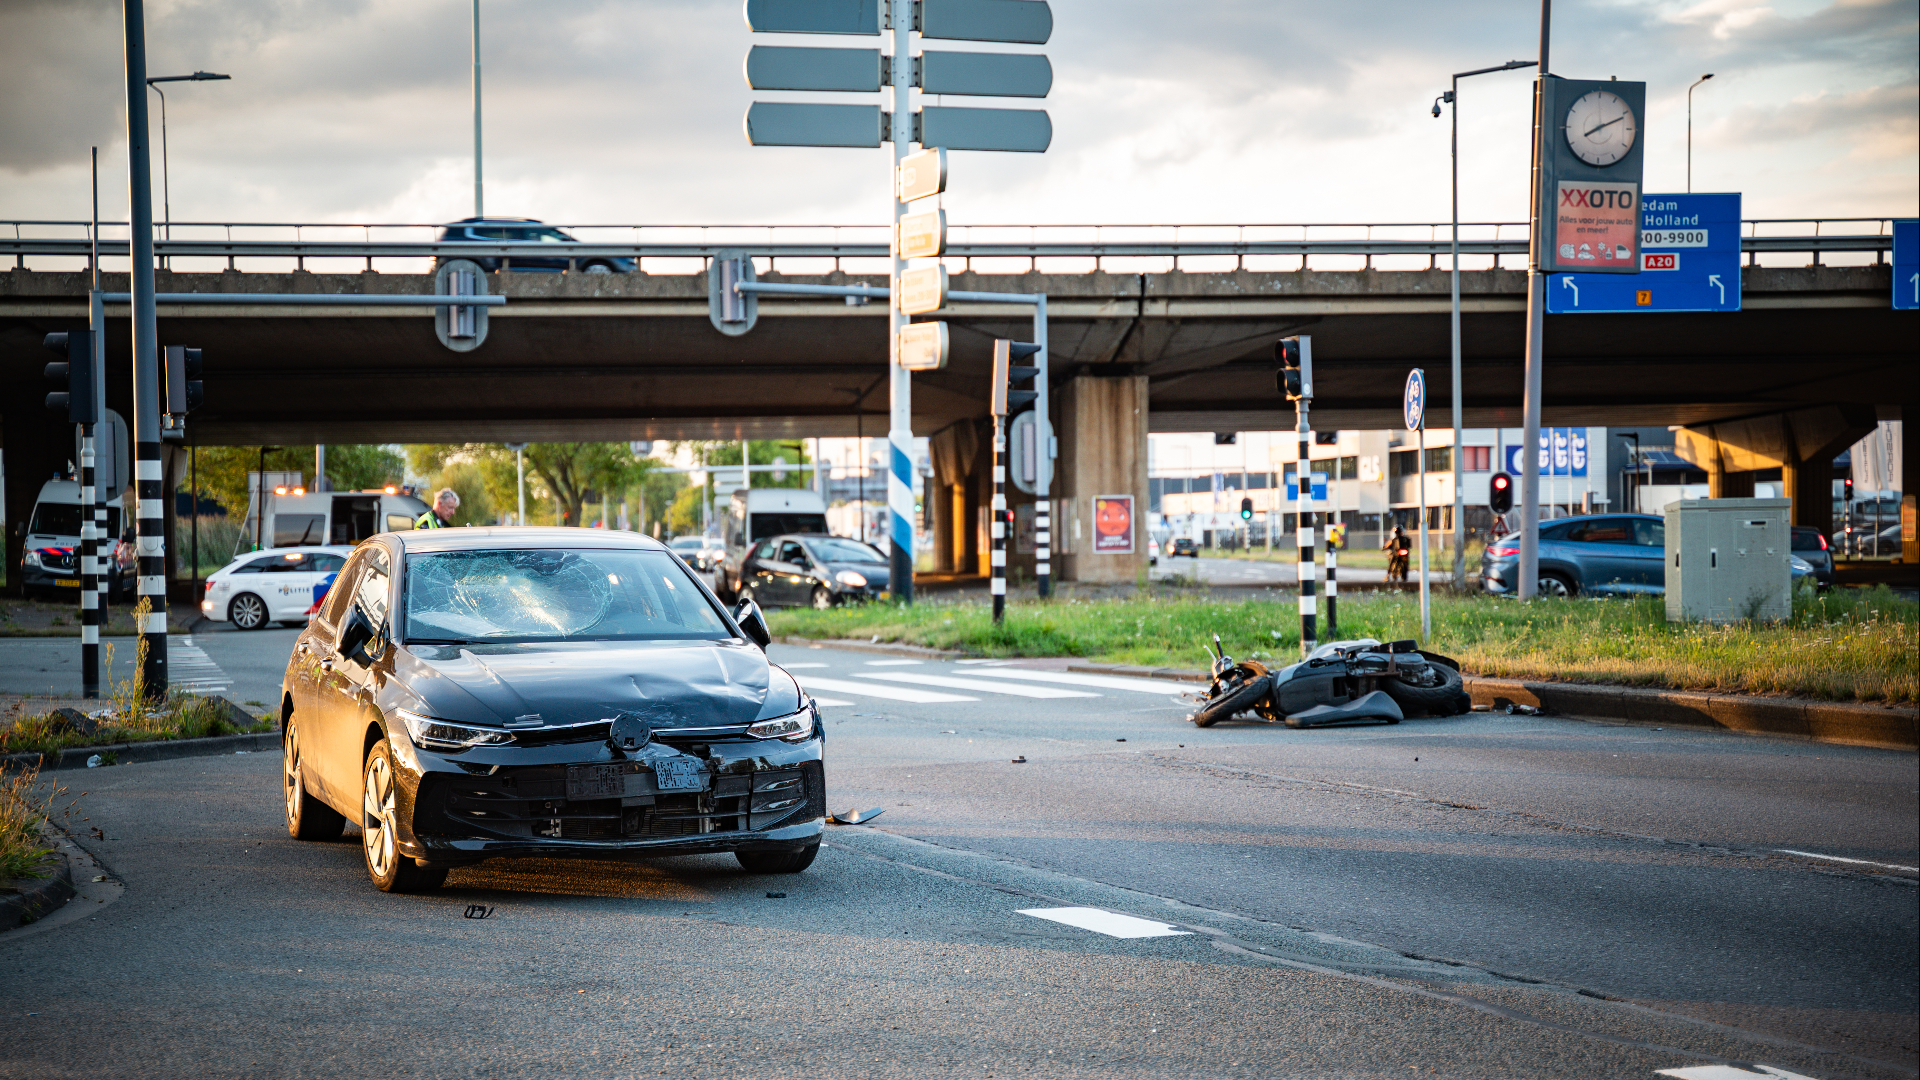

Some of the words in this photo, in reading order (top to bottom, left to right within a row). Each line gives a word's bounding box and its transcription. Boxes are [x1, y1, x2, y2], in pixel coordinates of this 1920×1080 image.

[1560, 188, 1633, 209] XXOTO
[1642, 199, 1678, 211] edam
[1559, 215, 1578, 224] Alles
[1579, 217, 1595, 225] voor
[1596, 216, 1615, 226] jouw
[1616, 218, 1634, 226] auto
[1645, 214, 1699, 226] Holland
[1647, 256, 1673, 267] A20
